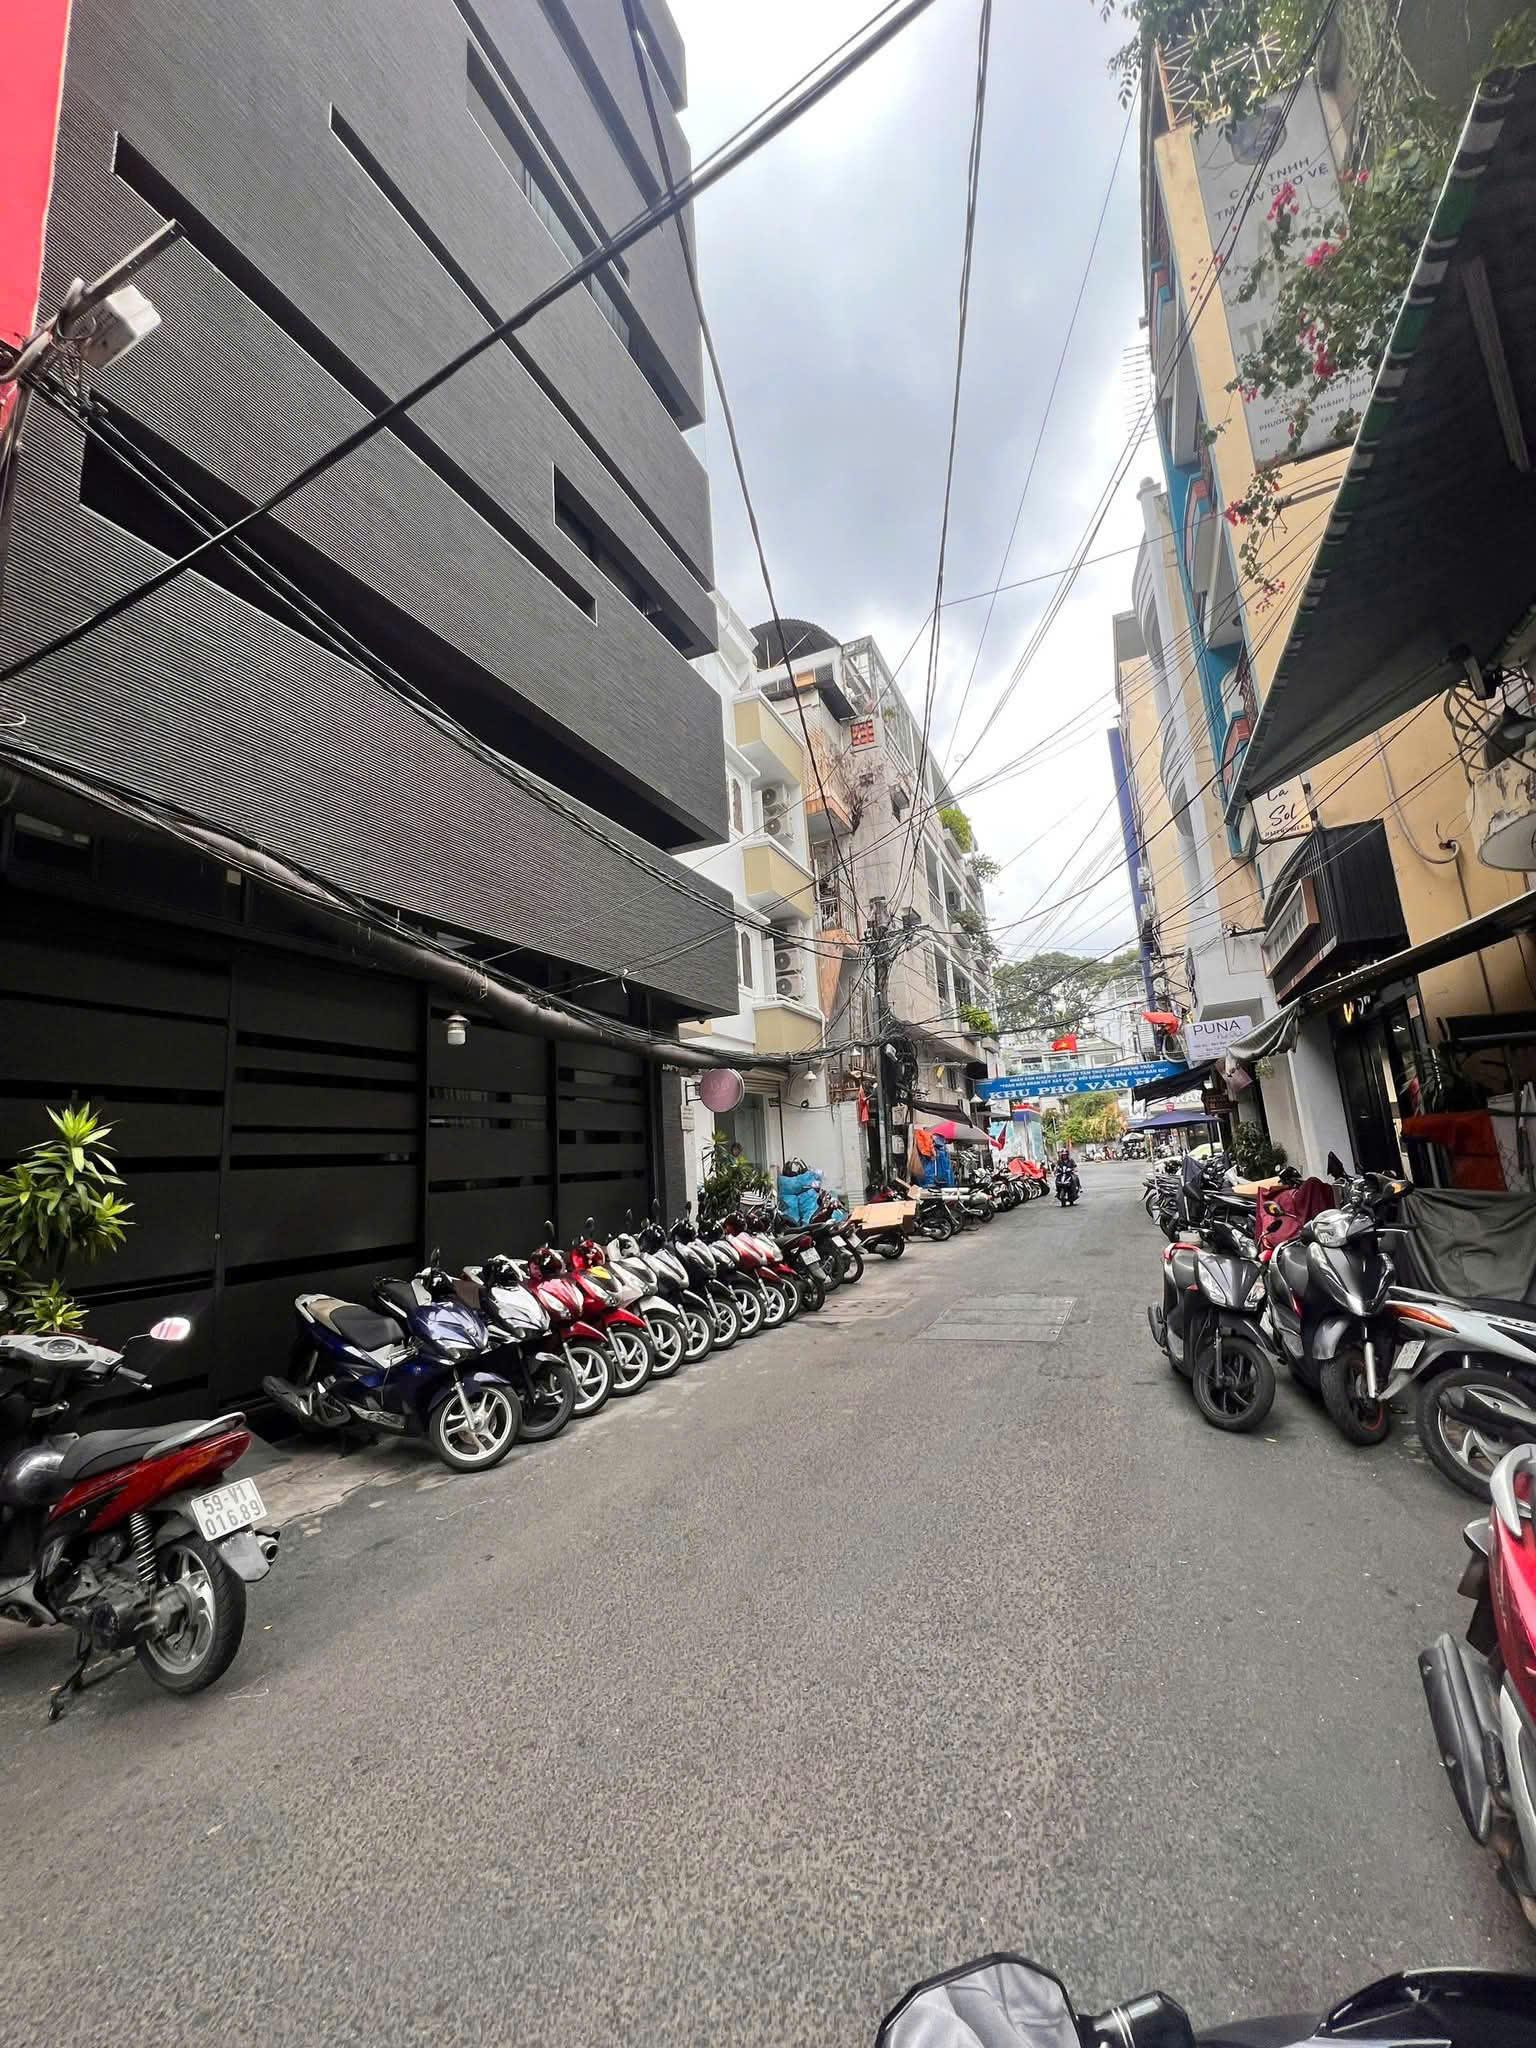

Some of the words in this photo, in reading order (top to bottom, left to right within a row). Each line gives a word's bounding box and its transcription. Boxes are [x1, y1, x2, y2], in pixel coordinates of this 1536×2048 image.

[1268, 157, 1310, 181] TNHH
[1266, 789, 1288, 801] La
[1269, 803, 1296, 827] Sol
[1193, 1020, 1240, 1036] PUNA
[989, 1088, 1030, 1099] KHU
[1037, 1081, 1079, 1095] PHỐ
[1086, 1078, 1129, 1091] VĂN
[203, 1486, 247, 1515] 59-V1
